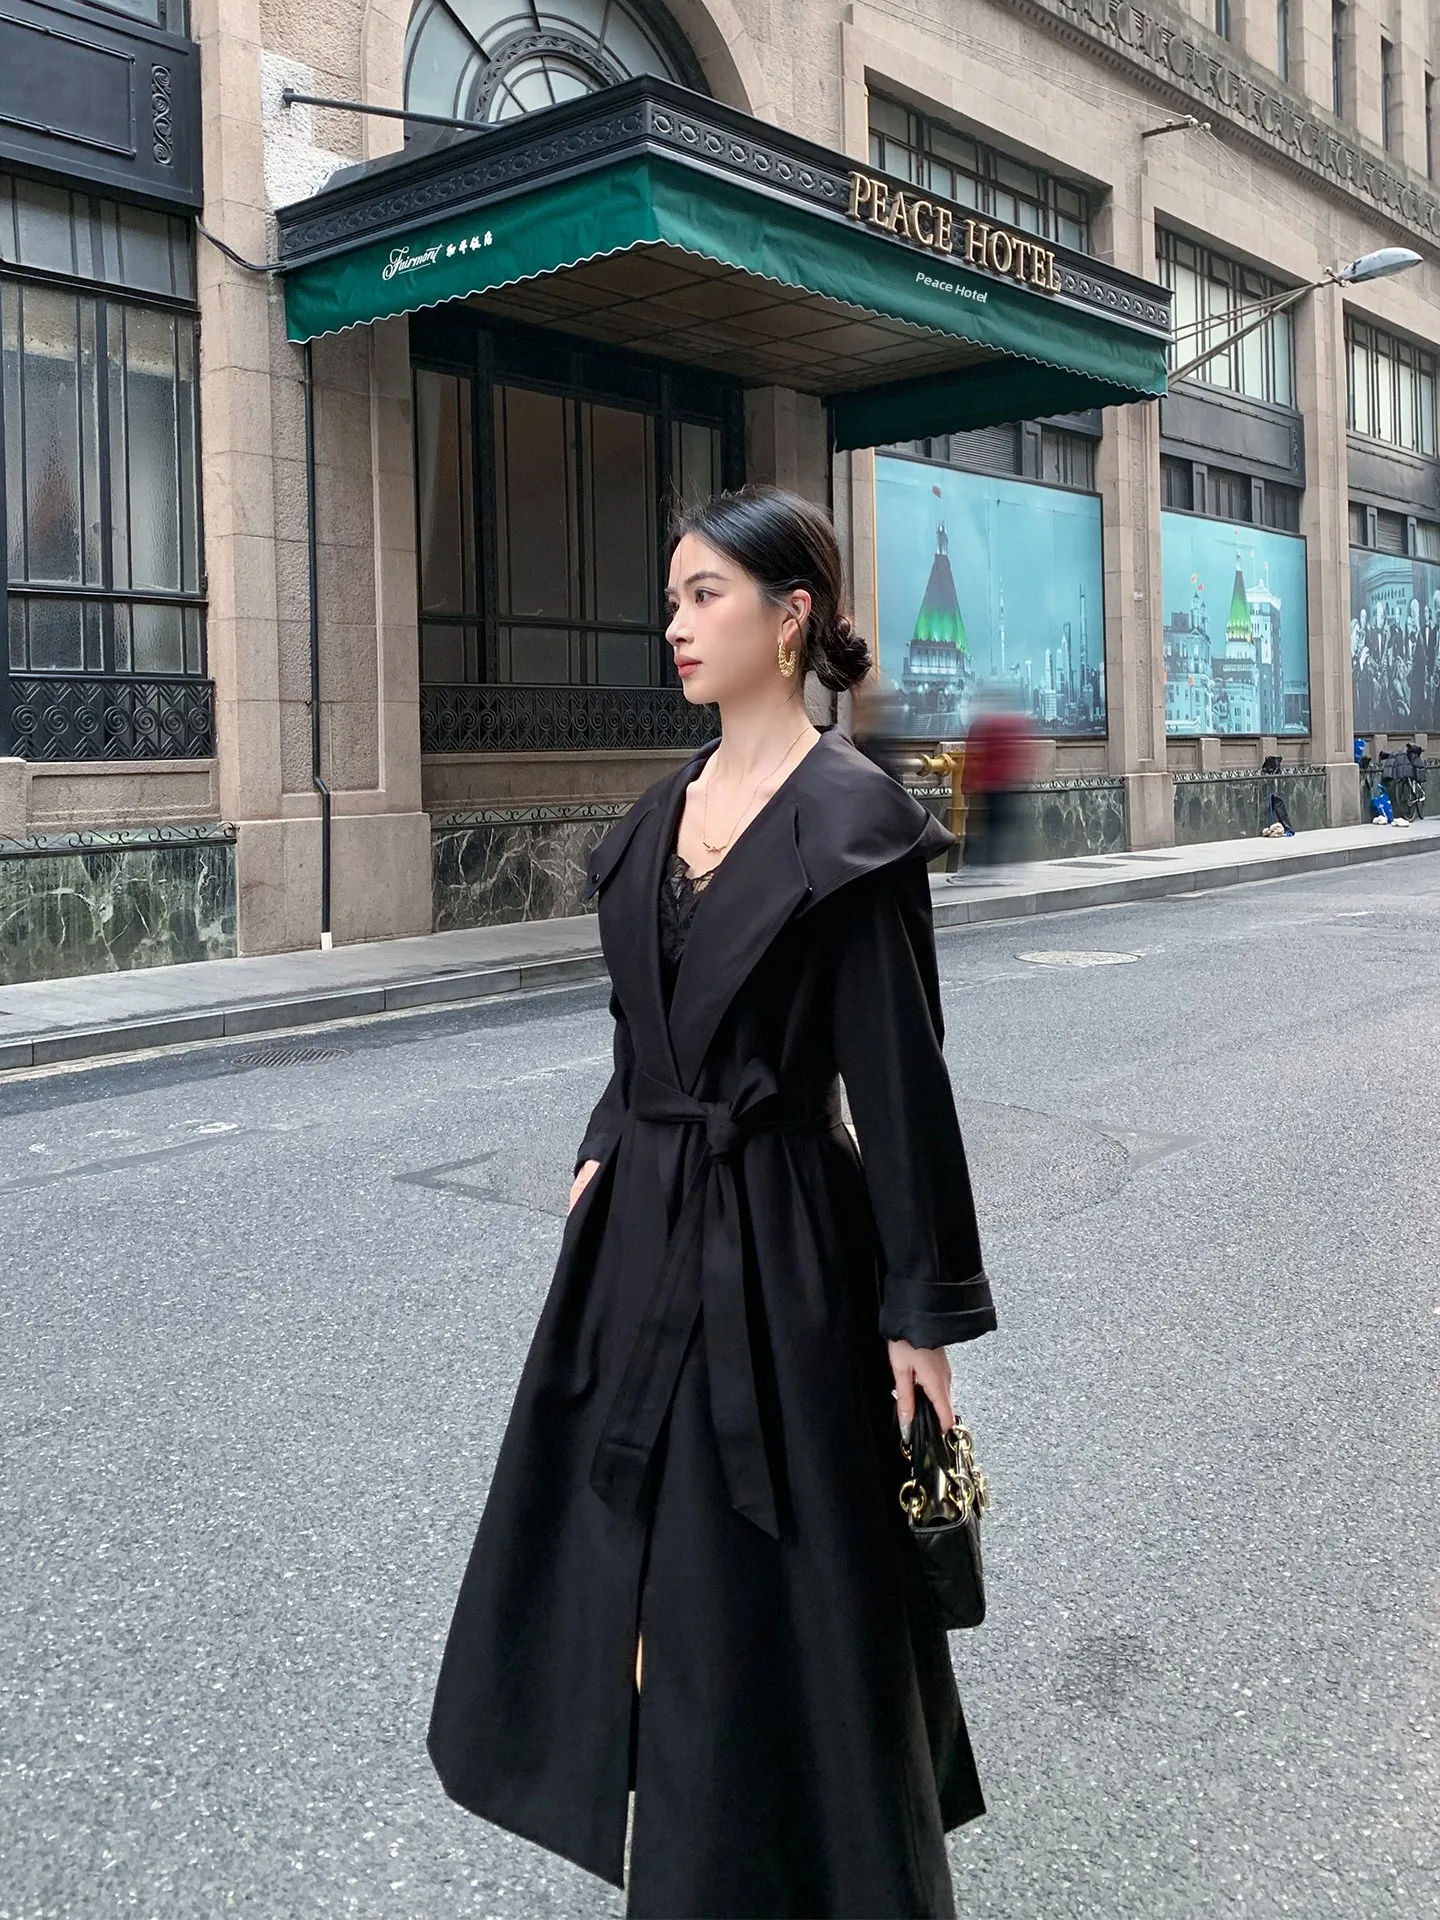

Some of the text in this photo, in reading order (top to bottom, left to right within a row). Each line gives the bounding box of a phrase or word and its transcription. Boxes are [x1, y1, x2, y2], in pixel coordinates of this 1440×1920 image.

[845, 170, 1062, 294] PEACE HOTEL
[382, 243, 443, 281] Fairmont
[915, 271, 988, 304] Peace Hotel
